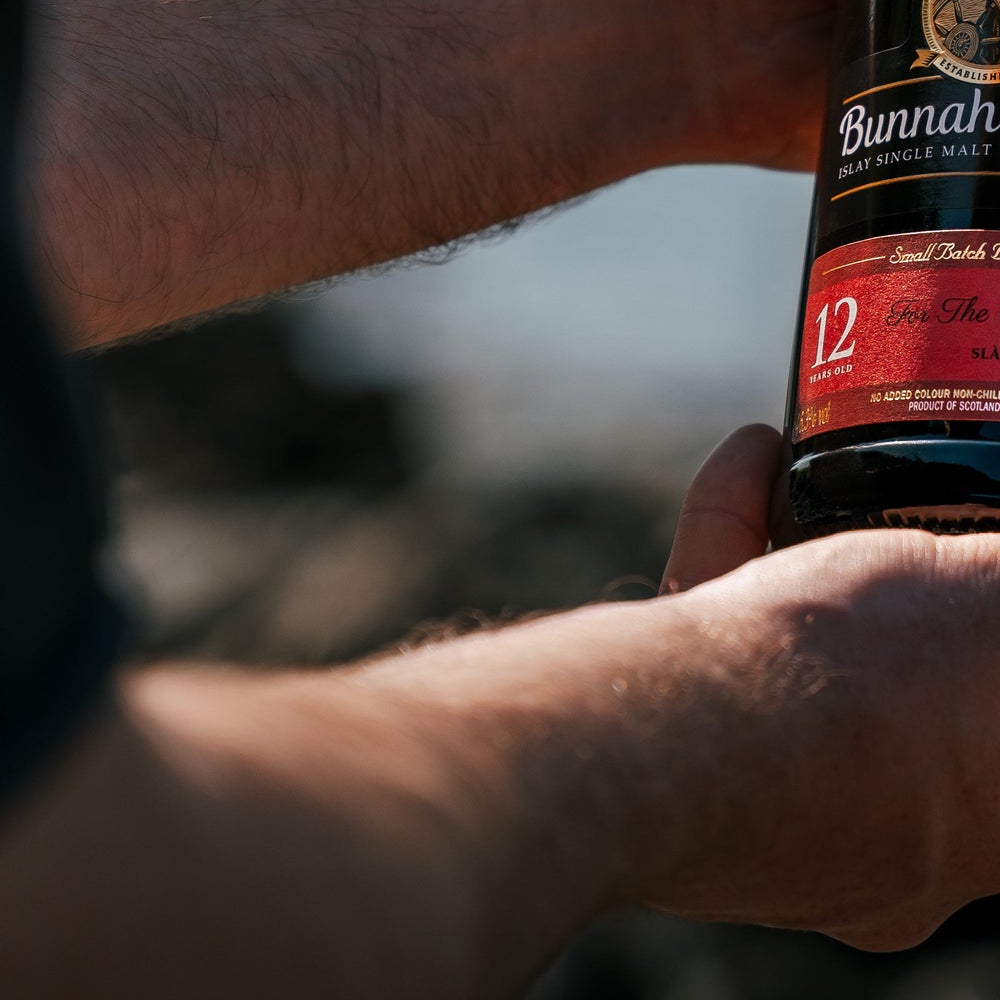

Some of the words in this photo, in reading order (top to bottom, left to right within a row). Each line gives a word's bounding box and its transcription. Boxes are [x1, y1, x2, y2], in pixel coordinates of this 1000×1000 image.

[838, 157, 872, 179] ISLAY
[876, 146, 934, 167] SINGLE
[941, 143, 993, 158] MALT
[889, 242, 938, 264] Small
[934, 242, 988, 261] Batch
[886, 298, 930, 327] For
[936, 295, 990, 325] The
[811, 297, 858, 369] 12
[809, 369, 832, 384] YEARS
[834, 364, 853, 376] OLD
[870, 392, 882, 403] NO
[883, 390, 912, 401] ADDED
[914, 388, 951, 400] COLOUR
[908, 400, 945, 411] PRODUCT
[946, 400, 957, 411] OF
[959, 400, 1000, 412] SCOTLAND
